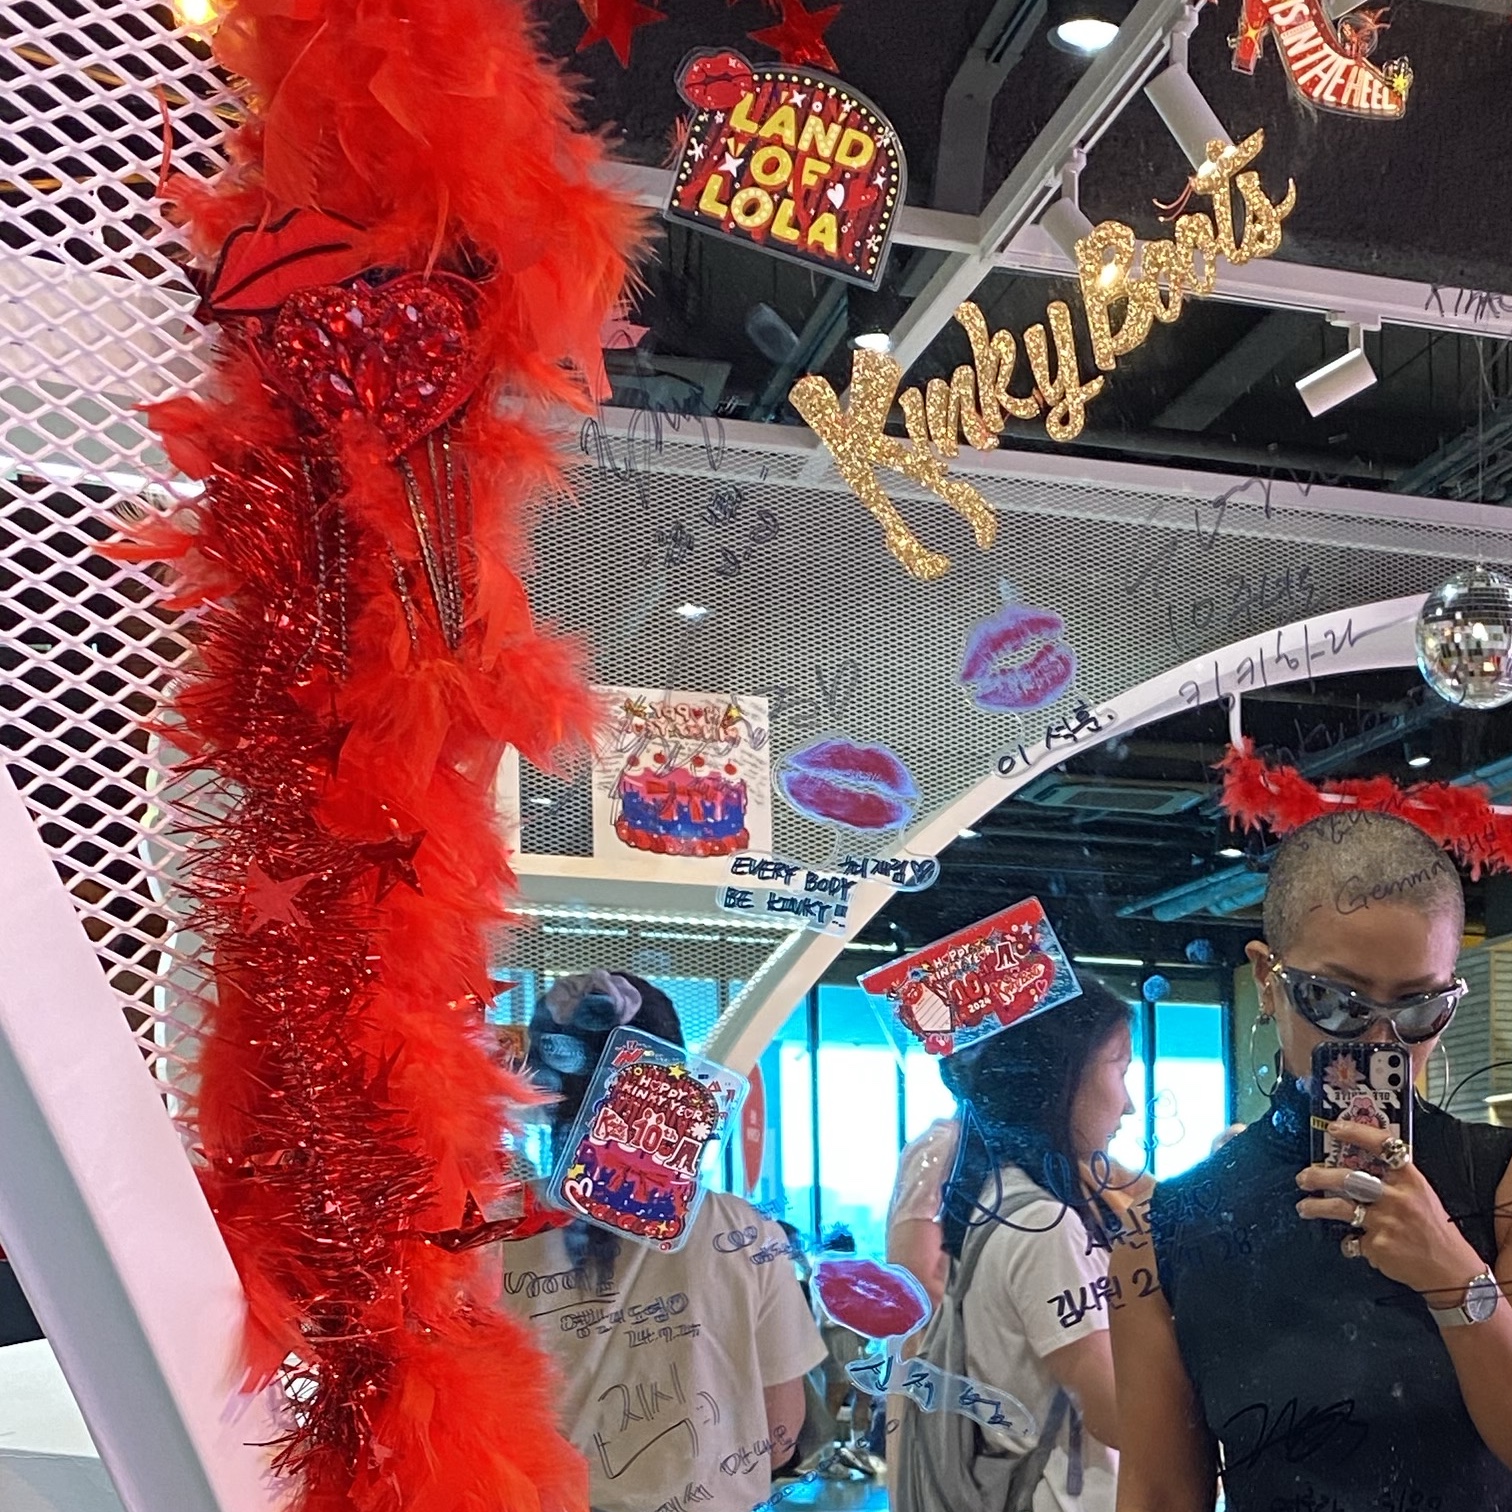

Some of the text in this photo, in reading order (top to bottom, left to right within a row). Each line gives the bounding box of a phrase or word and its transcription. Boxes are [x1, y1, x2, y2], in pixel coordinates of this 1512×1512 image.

[1340, 65, 1398, 110] HEEL
[729, 92, 874, 169] LAND
[750, 145, 831, 188] OF
[698, 174, 839, 255] LOLA
[789, 300, 1106, 583] Kinky
[1073, 127, 1297, 372] Boots
[724, 887, 755, 909] BE
[731, 857, 858, 900] EVERY BODY
[967, 997, 992, 1013] 2024
[622, 1083, 664, 1107] KINKY
